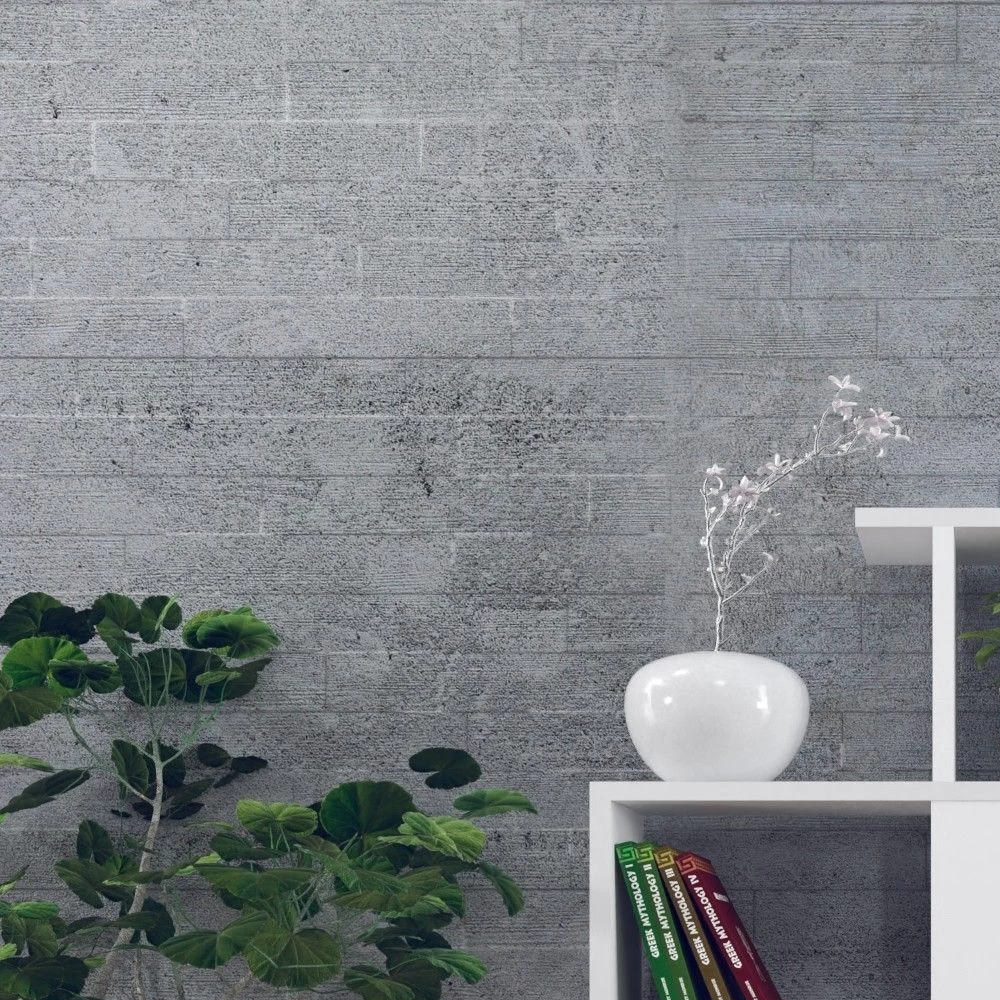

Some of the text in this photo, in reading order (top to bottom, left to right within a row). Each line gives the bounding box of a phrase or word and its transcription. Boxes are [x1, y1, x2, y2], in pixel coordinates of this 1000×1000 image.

[628, 871, 650, 928] MYTHOLOGY
[646, 874, 669, 929] MYTHOLOGY
[665, 868, 710, 965] GREEK MYTHOLOGY III
[688, 874, 742, 969] GREEK MYTHOLOGY IV
[645, 928, 660, 958] GREEK
[664, 932, 678, 961] GREEK
